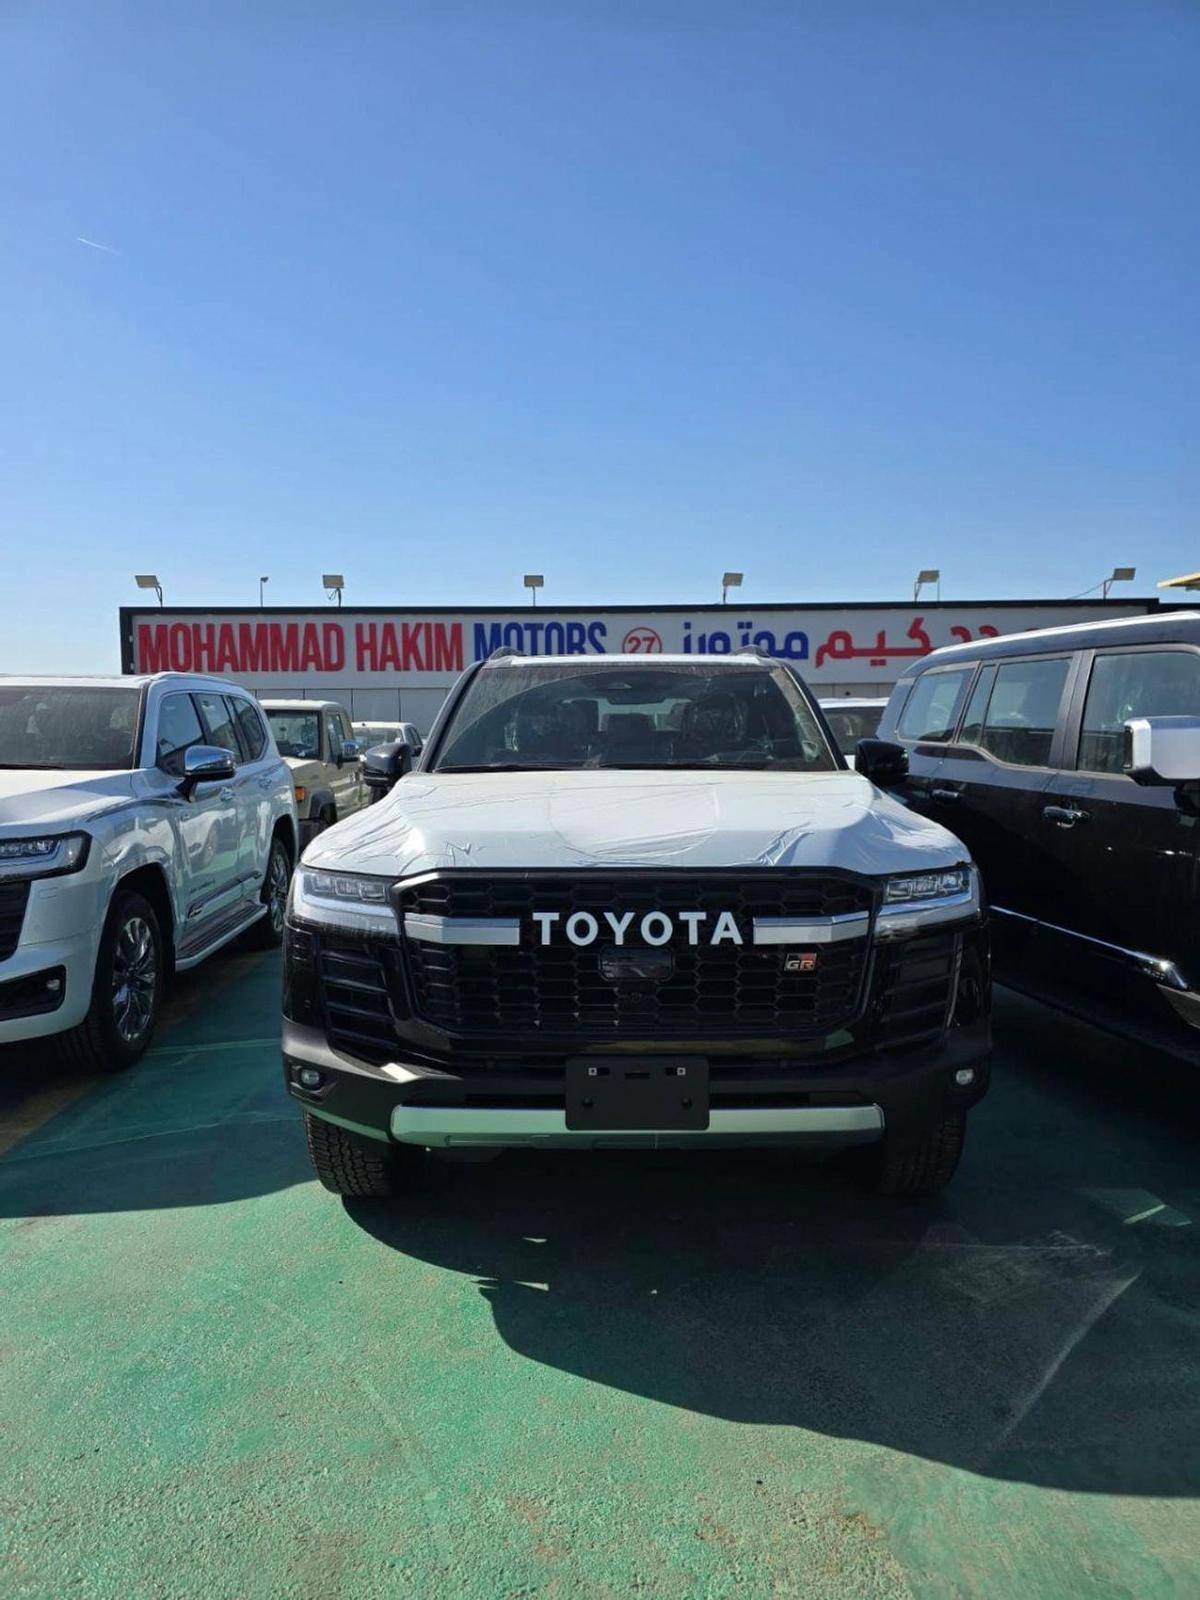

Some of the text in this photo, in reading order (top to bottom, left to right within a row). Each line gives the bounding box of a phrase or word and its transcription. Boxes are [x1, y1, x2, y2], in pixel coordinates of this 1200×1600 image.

[137, 621, 607, 672] MOHAMMAD HAKIM MOTORS
[628, 636, 656, 654] 27
[532, 911, 744, 946] TOYOTA
[786, 960, 815, 970] GR
